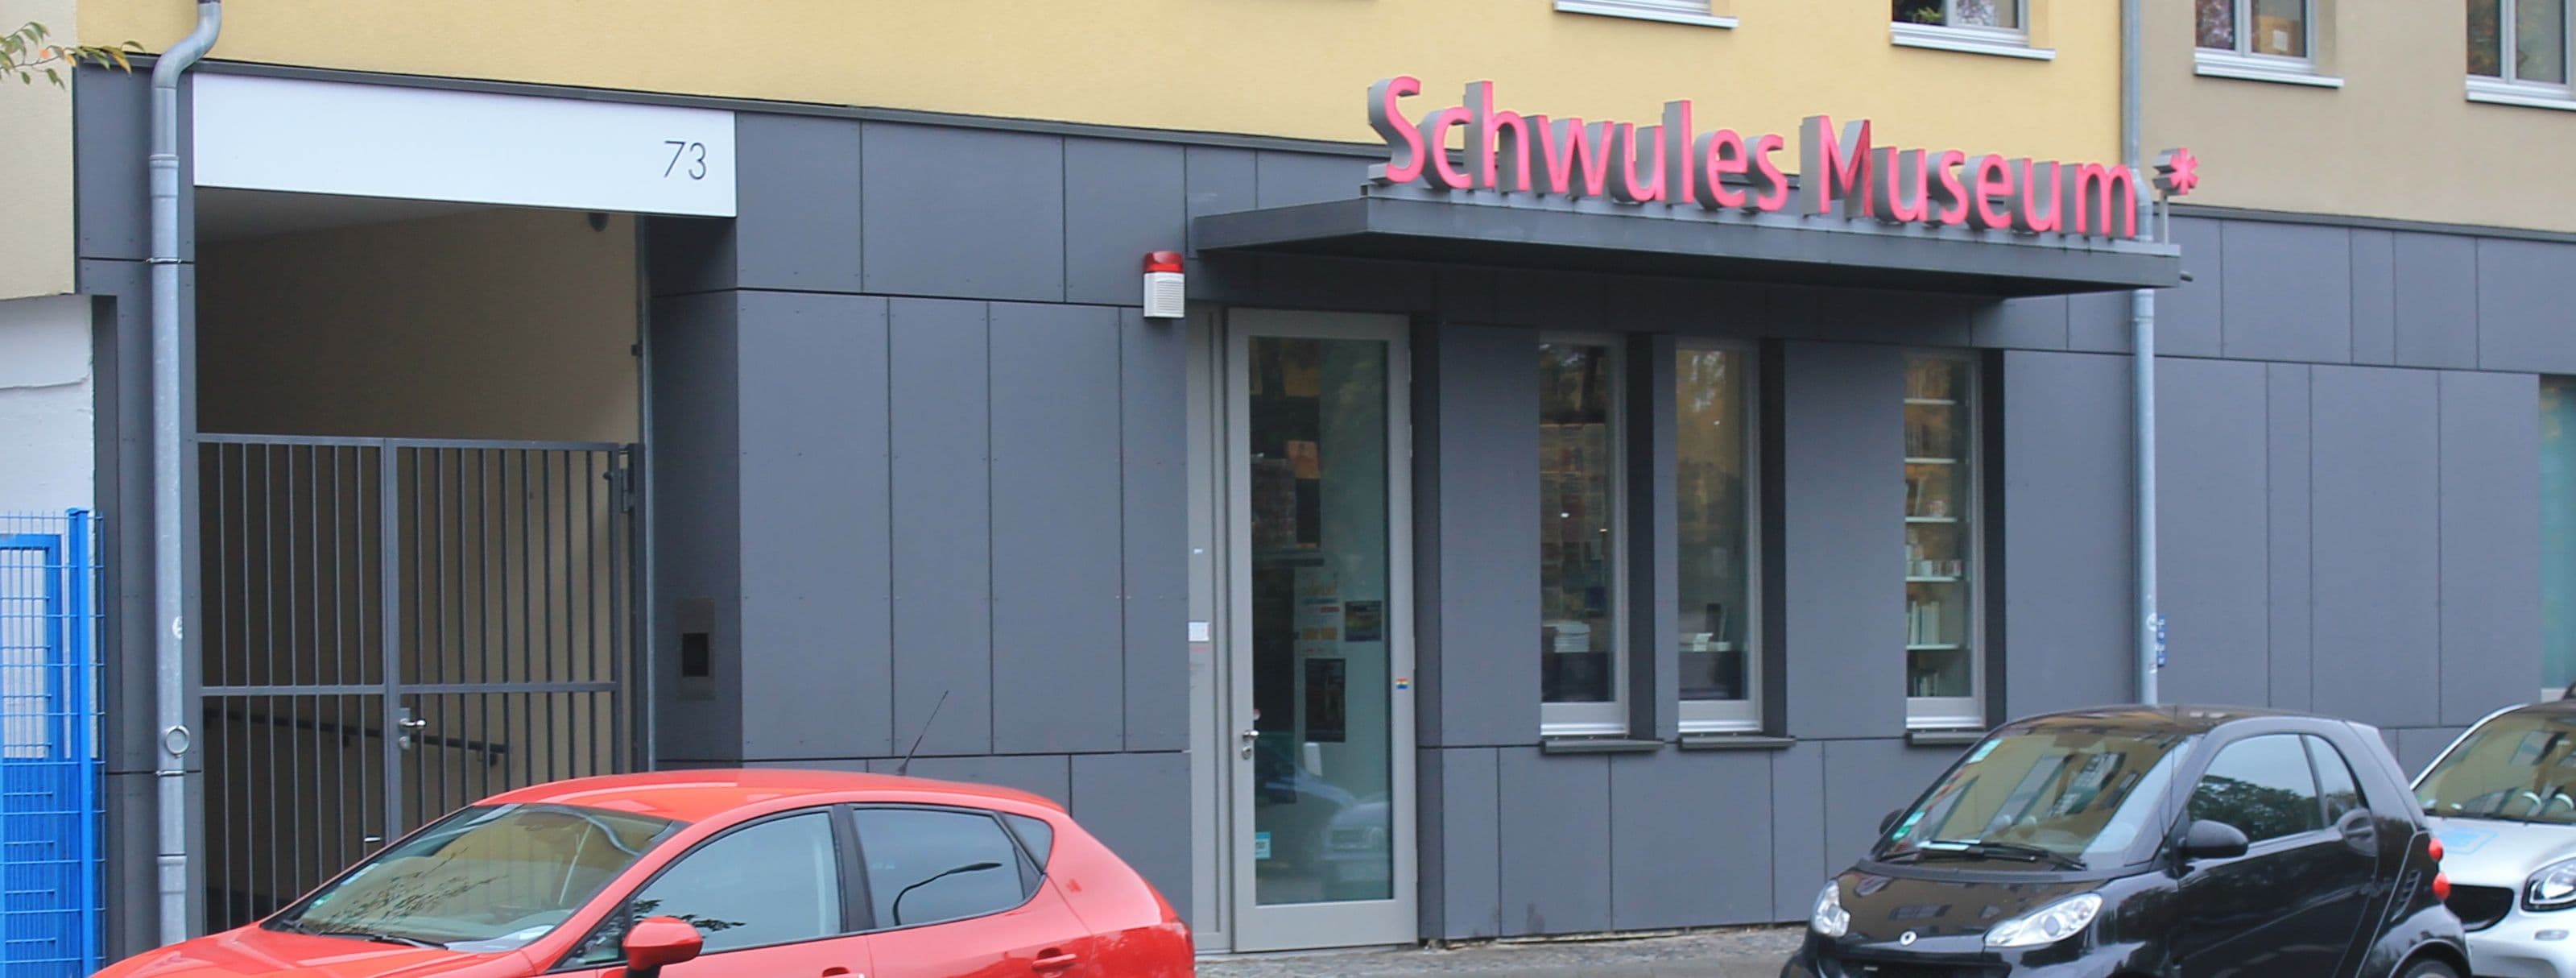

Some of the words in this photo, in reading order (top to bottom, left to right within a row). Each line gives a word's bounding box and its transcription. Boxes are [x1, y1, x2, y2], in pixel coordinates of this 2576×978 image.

[664, 140, 706, 180] 73
[1382, 76, 1789, 213] Schwules
[1817, 114, 2136, 238] Museum
